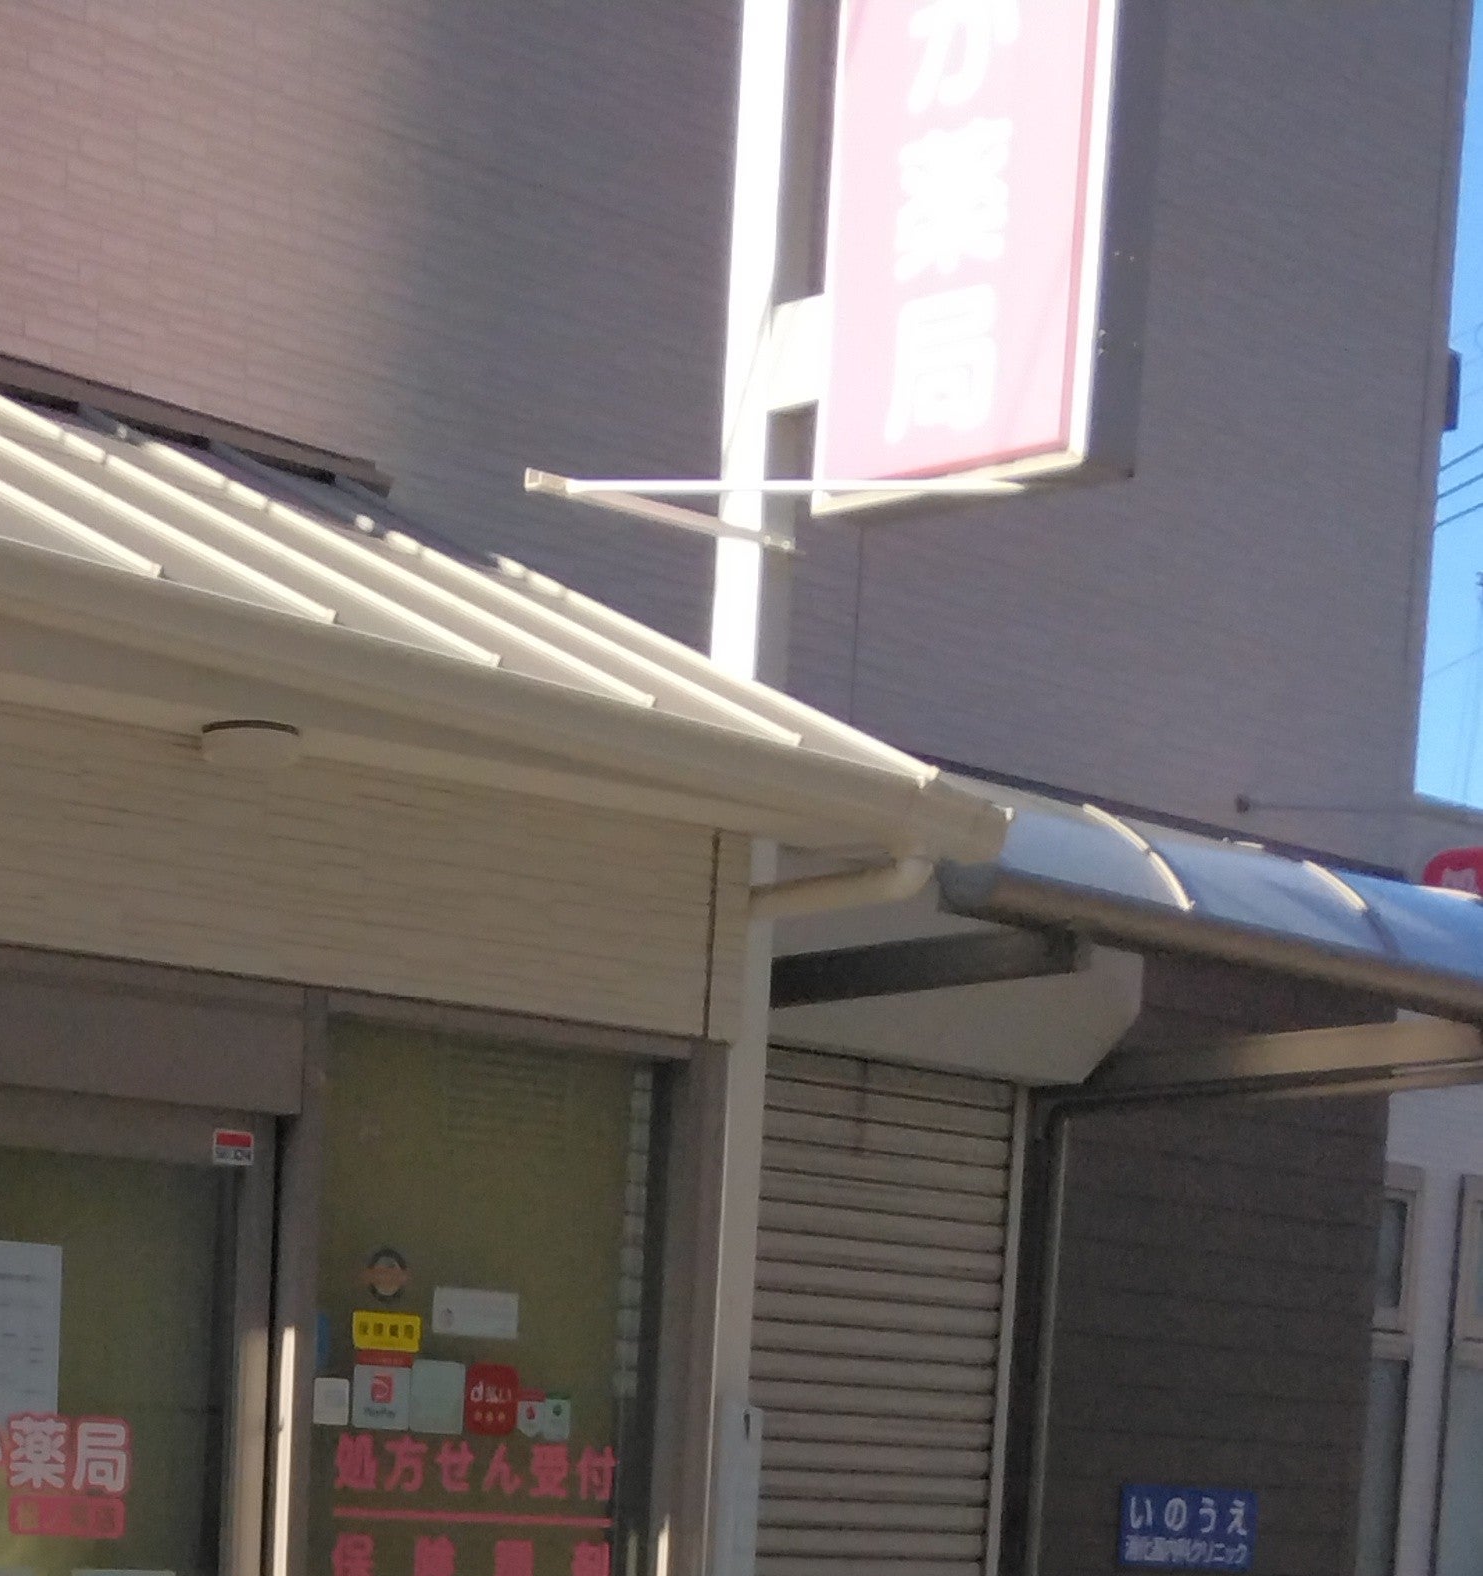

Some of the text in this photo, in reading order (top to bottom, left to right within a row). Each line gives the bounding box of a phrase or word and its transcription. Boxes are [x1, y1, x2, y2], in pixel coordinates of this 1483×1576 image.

[333, 1431, 616, 1502] 処方せん受付
[1129, 1496, 1248, 1536] いのうえ
